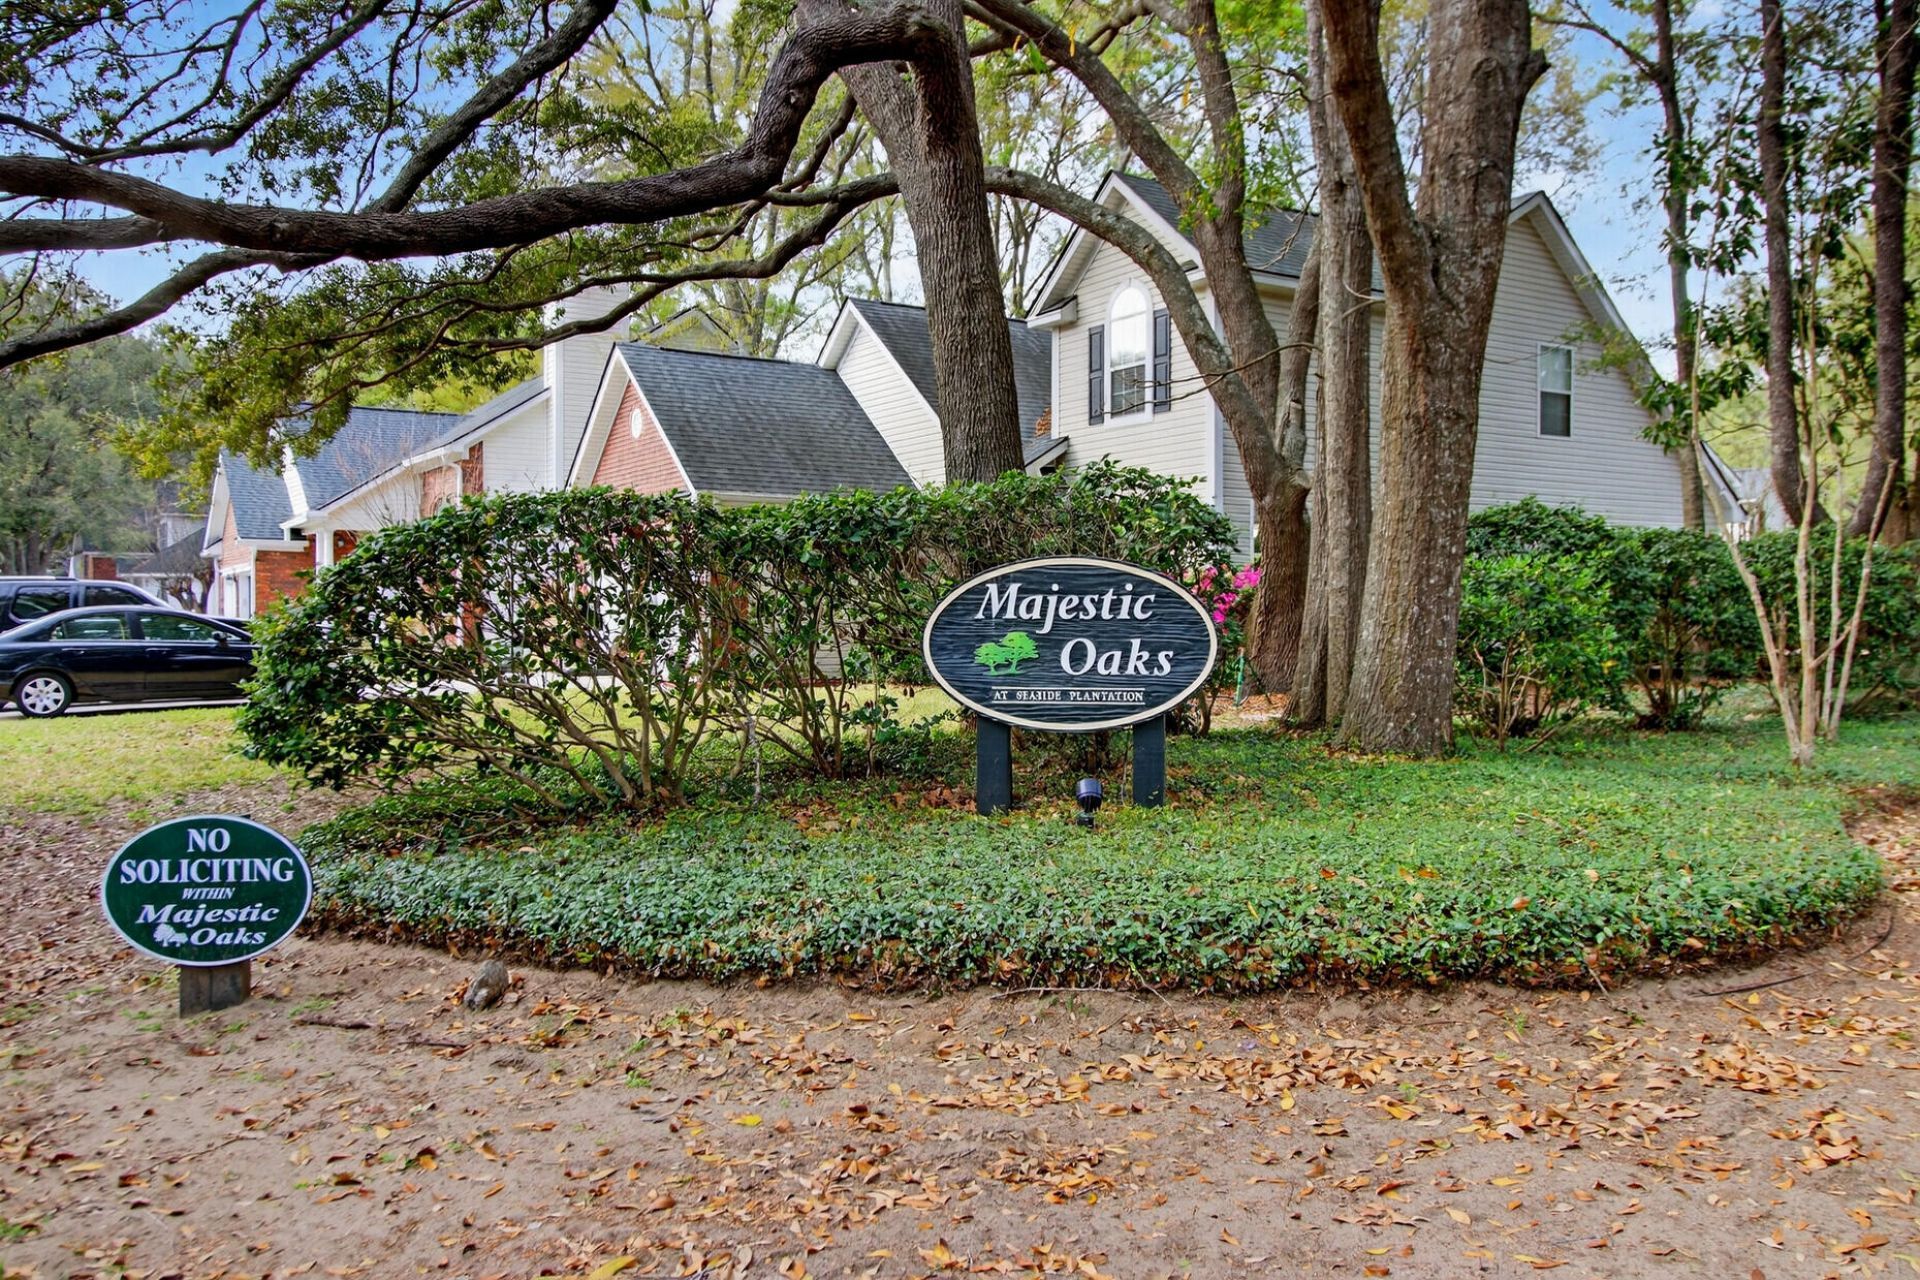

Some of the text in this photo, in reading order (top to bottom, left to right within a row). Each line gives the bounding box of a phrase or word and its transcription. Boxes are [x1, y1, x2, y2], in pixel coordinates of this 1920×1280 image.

[974, 583, 1155, 634] Majestic
[1060, 637, 1174, 676] Oaks
[993, 690, 1144, 701] AT SEASIDE PLANTATION
[187, 828, 231, 852] NO
[120, 858, 295, 884] SOLICITING
[181, 887, 236, 900] WITHIN
[135, 903, 280, 928] Majestic
[188, 927, 268, 946] Oaks
